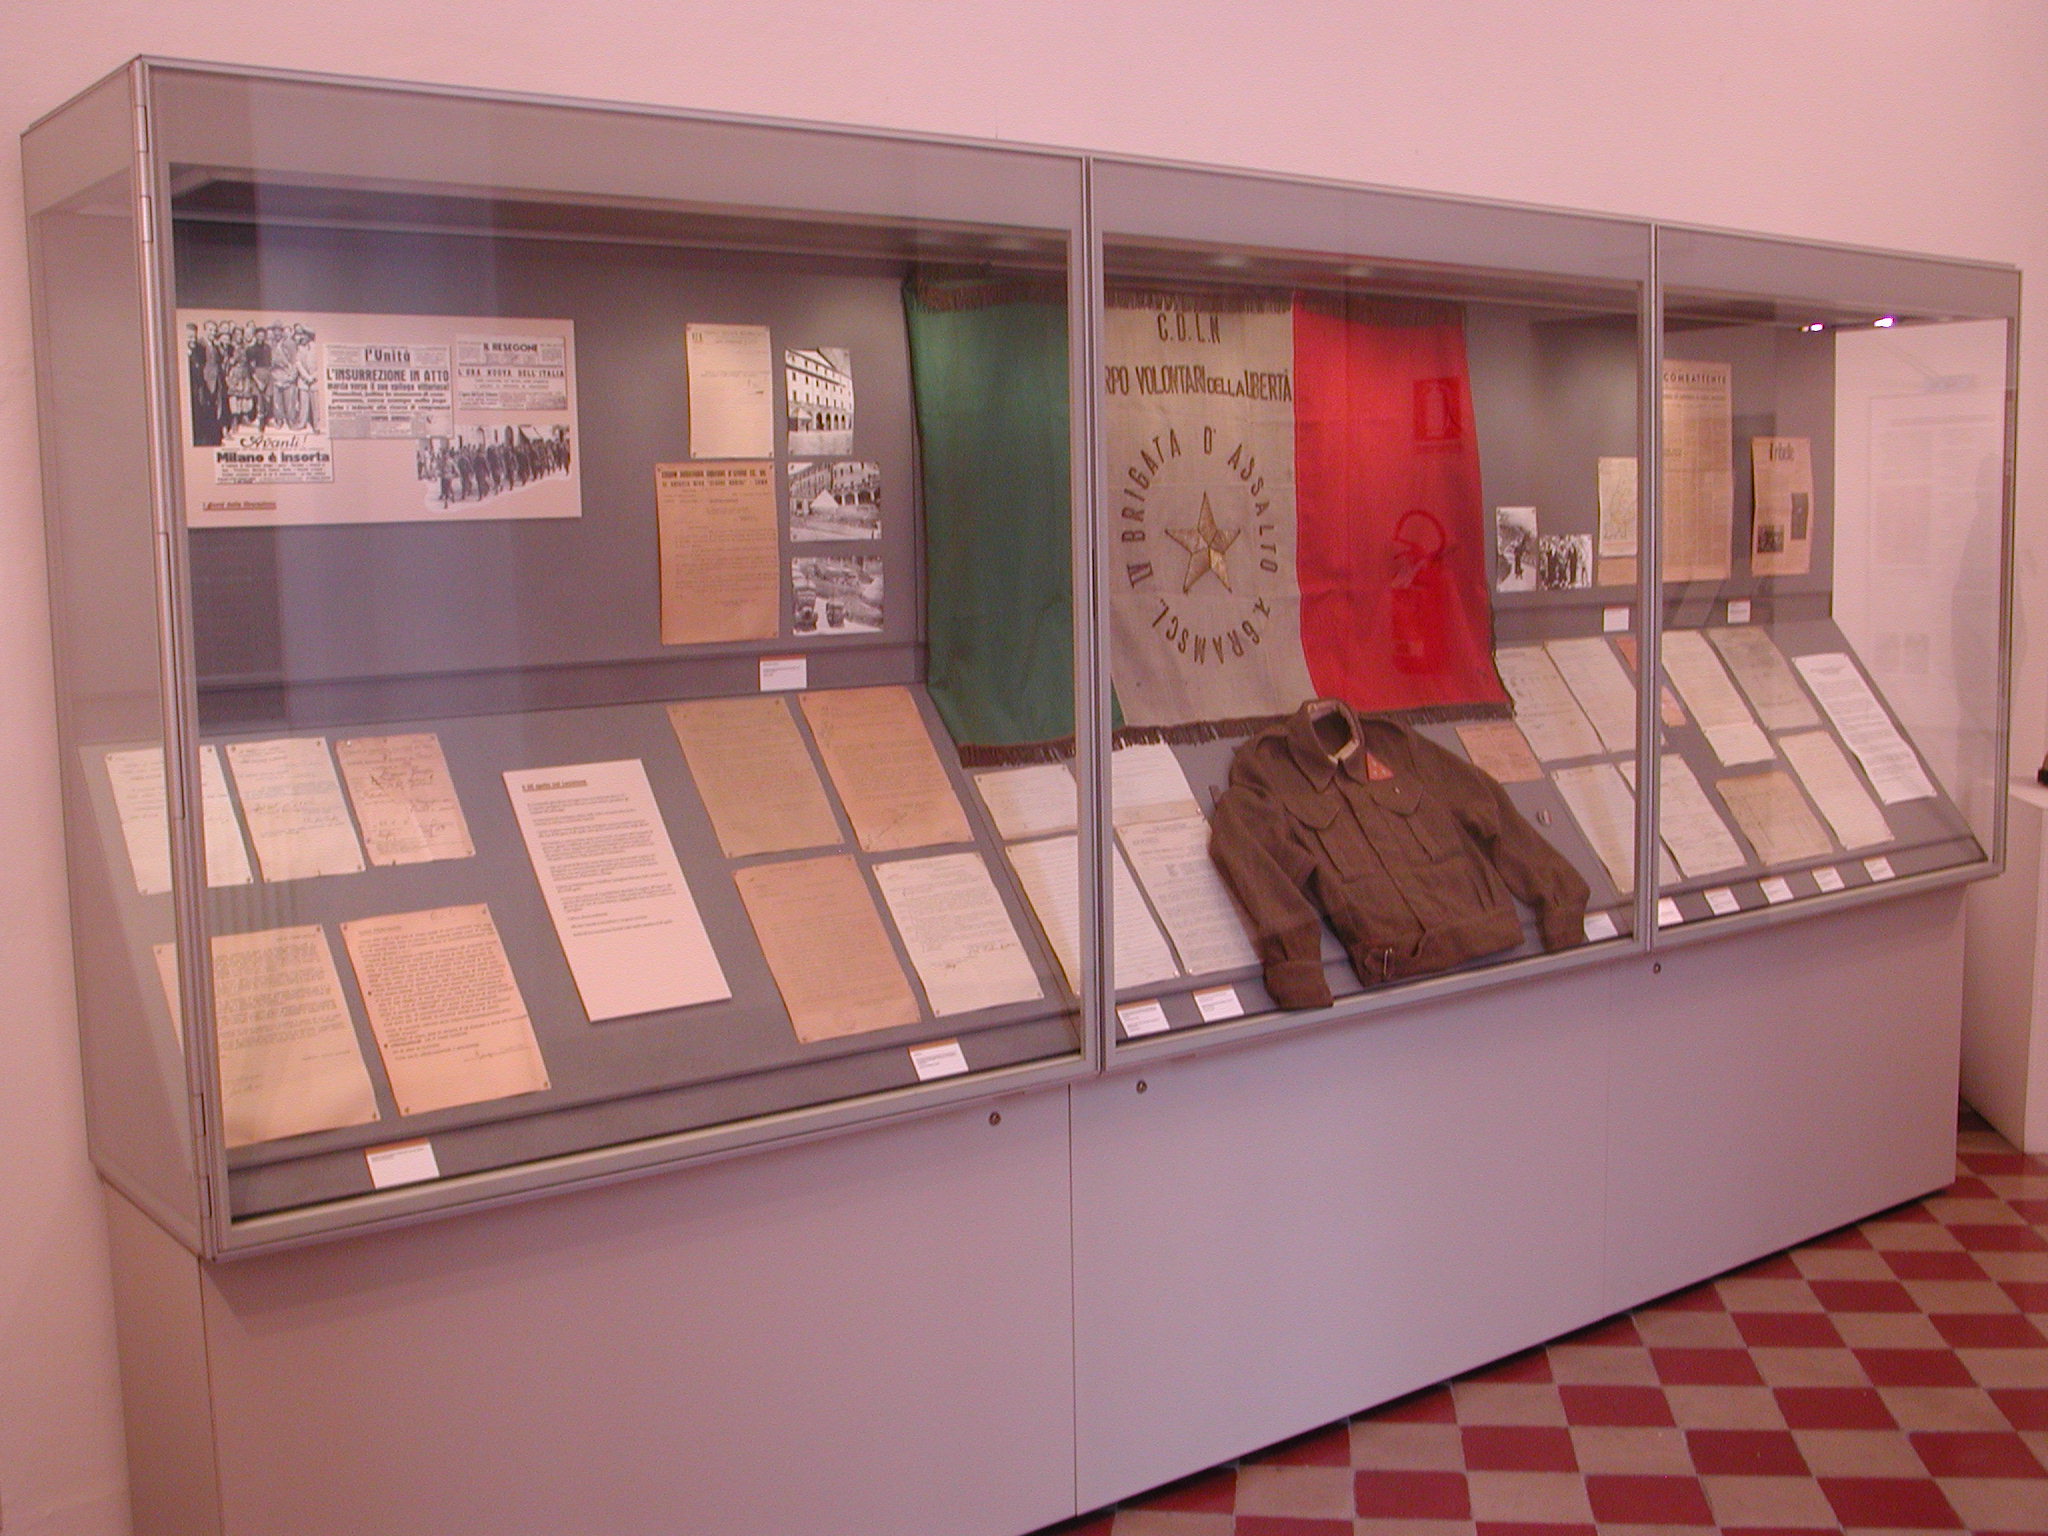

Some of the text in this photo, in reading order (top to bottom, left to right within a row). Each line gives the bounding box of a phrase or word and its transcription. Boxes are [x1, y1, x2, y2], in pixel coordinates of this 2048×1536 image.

[326, 368, 449, 382] L'INSURREZIONE IN ATTO
[216, 451, 264, 463] Milano
[1121, 428, 1182, 544] BRIGATA
[1227, 442, 1279, 574] ASSALTO
